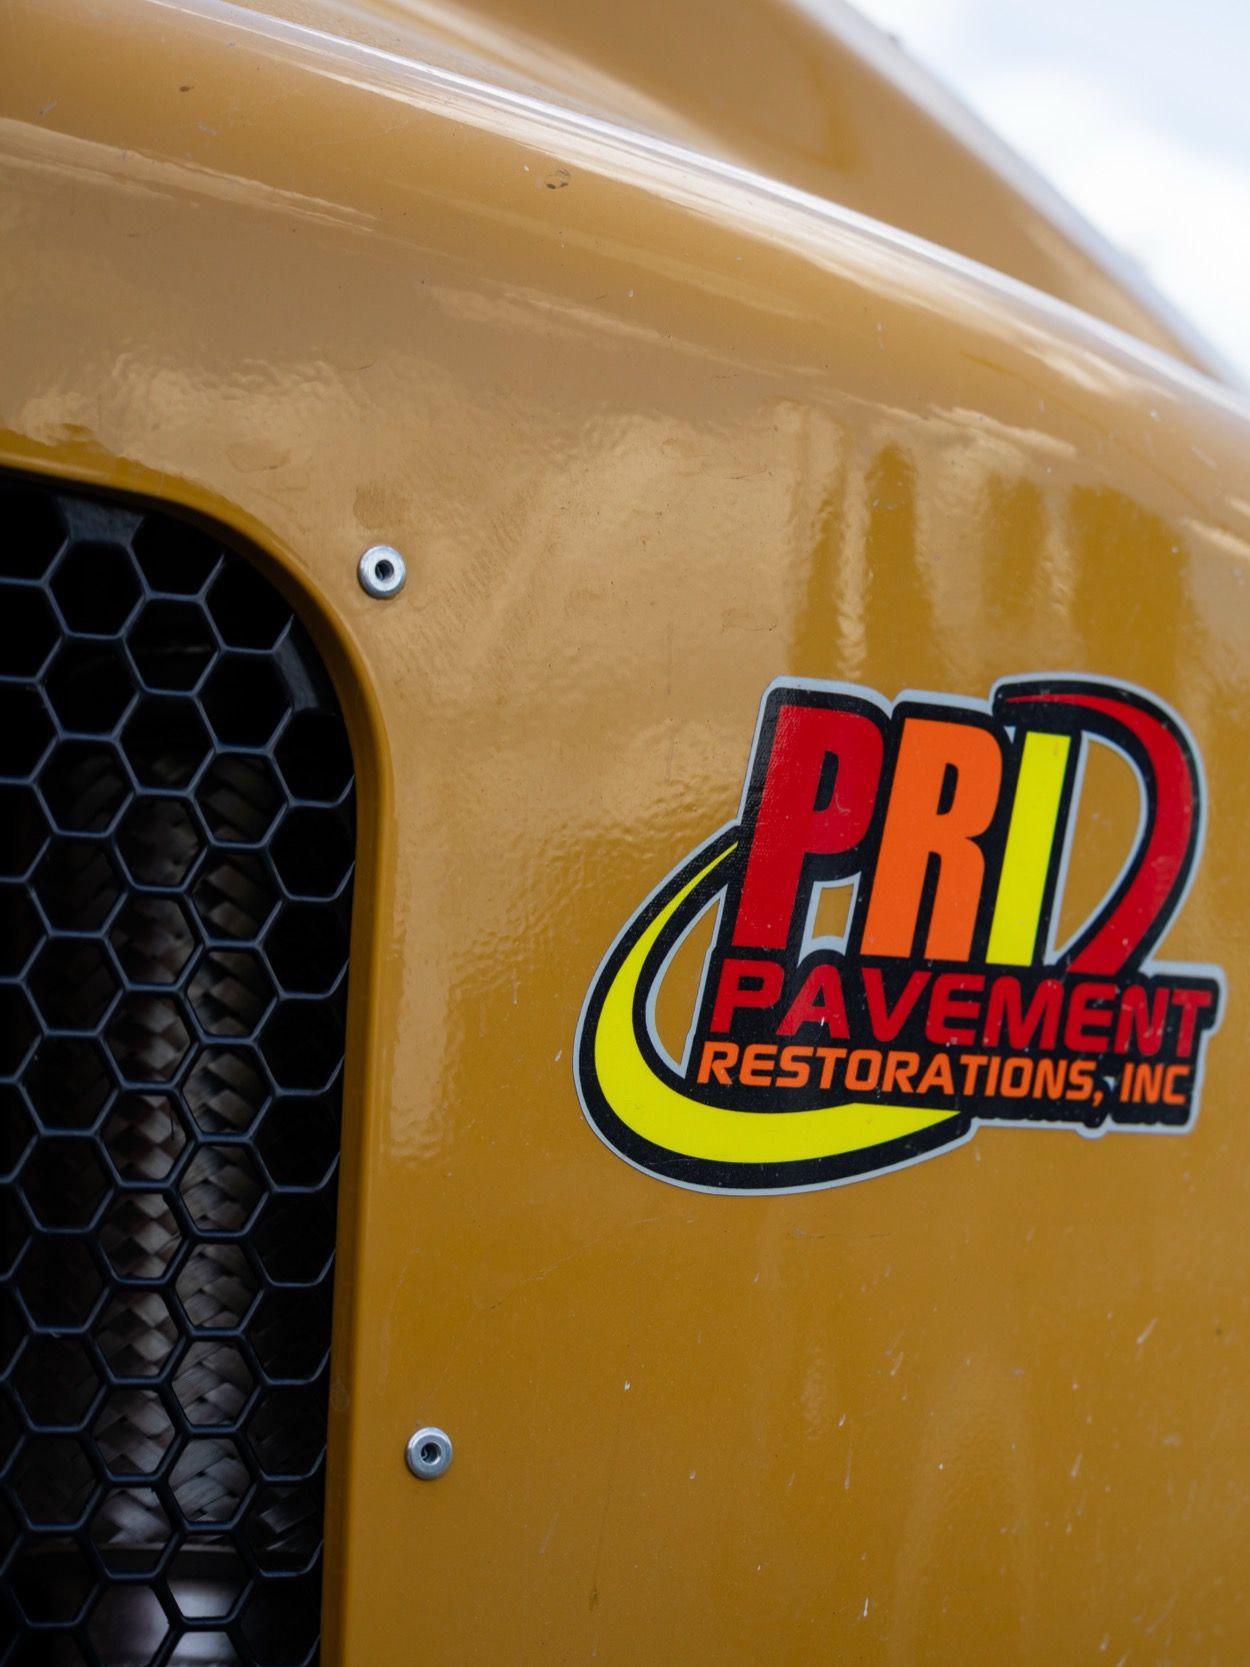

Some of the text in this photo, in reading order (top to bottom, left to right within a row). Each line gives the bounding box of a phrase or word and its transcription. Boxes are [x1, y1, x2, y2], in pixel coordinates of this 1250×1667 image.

[731, 704, 1071, 967] PRI
[709, 957, 1211, 1058] PAVEMENT
[697, 1040, 1191, 1107] RESTORATIONS, INC
